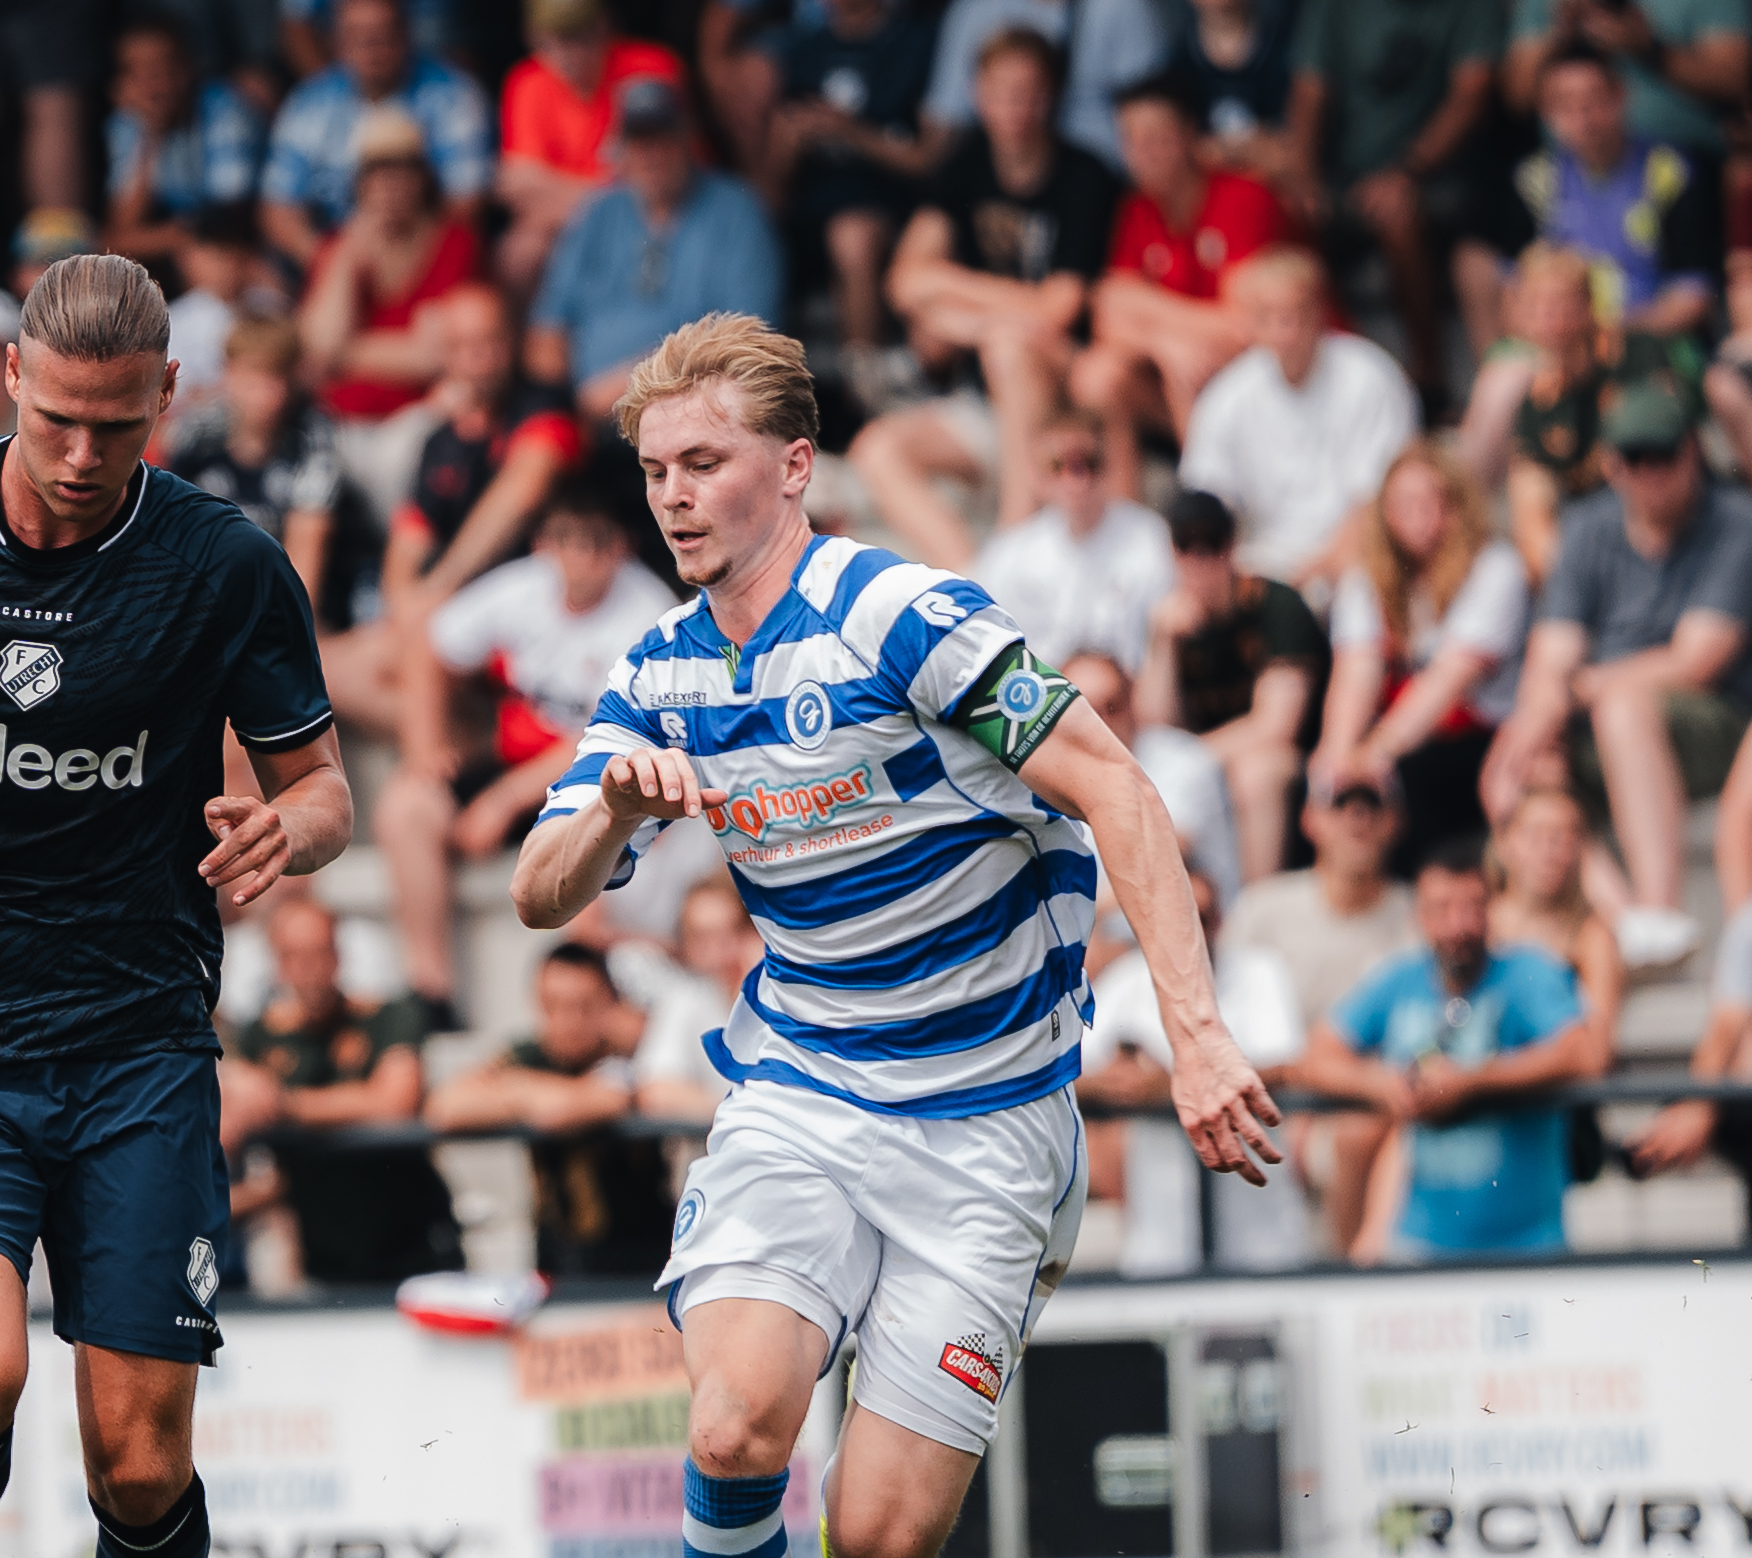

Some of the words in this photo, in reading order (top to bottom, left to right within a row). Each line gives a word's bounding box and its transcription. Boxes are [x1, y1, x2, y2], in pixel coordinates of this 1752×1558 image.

[1, 606, 74, 622] CASTORE
[5, 651, 57, 693] UTRECHT
[784, 842, 795, 858] &
[799, 814, 894, 855] shortlease
